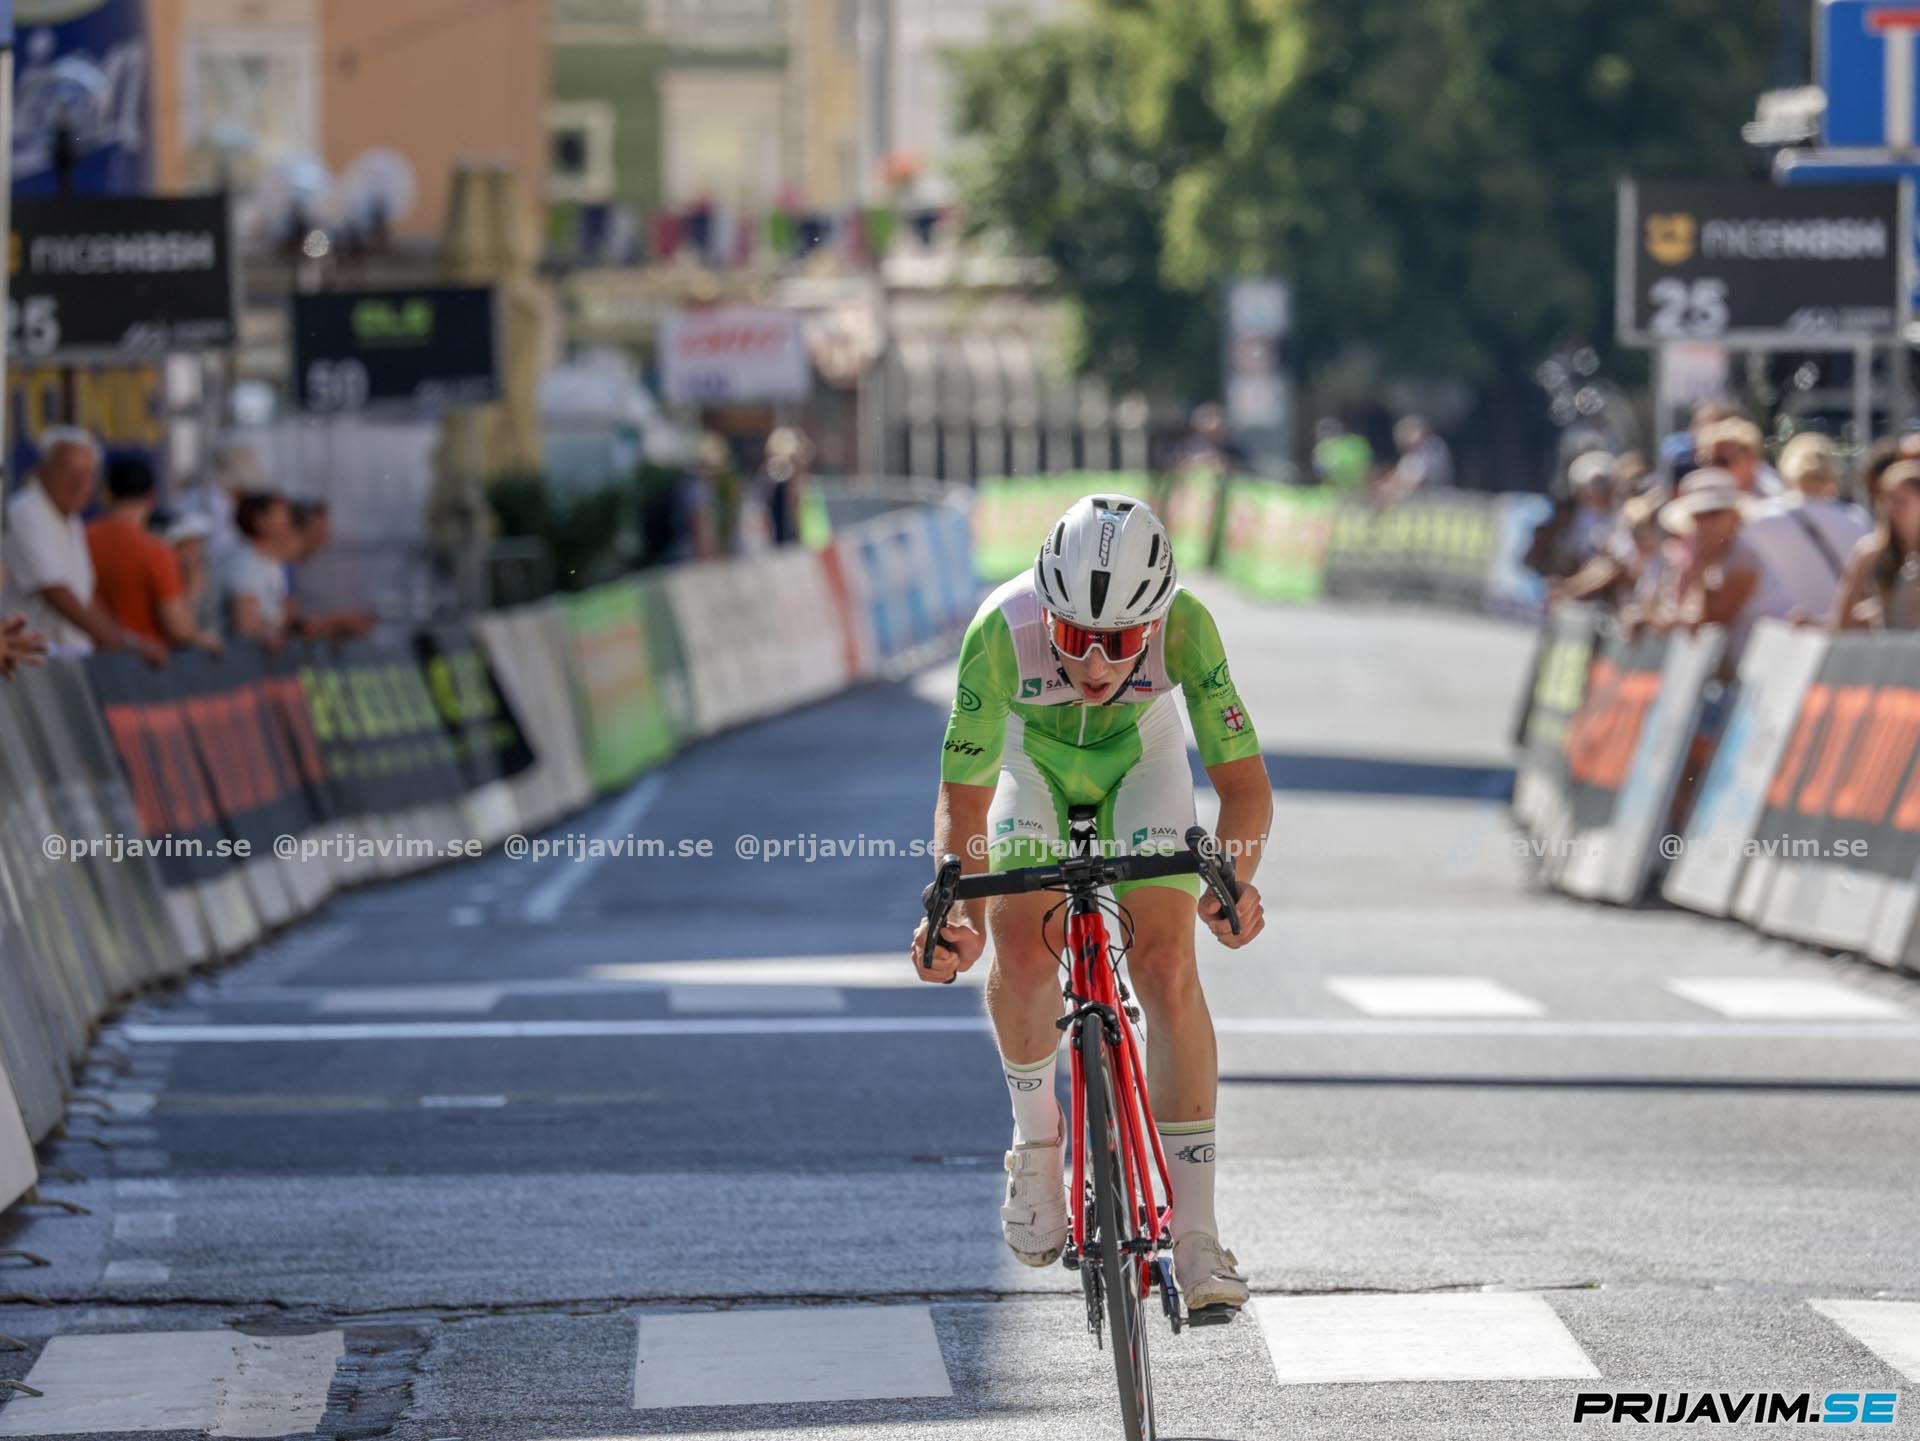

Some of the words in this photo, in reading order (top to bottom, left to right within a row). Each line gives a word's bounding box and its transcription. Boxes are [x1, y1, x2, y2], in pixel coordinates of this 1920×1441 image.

[1650, 277, 1730, 338] 25
[1018, 819, 1044, 832] SAVA
[1151, 827, 1177, 836] SAVA
